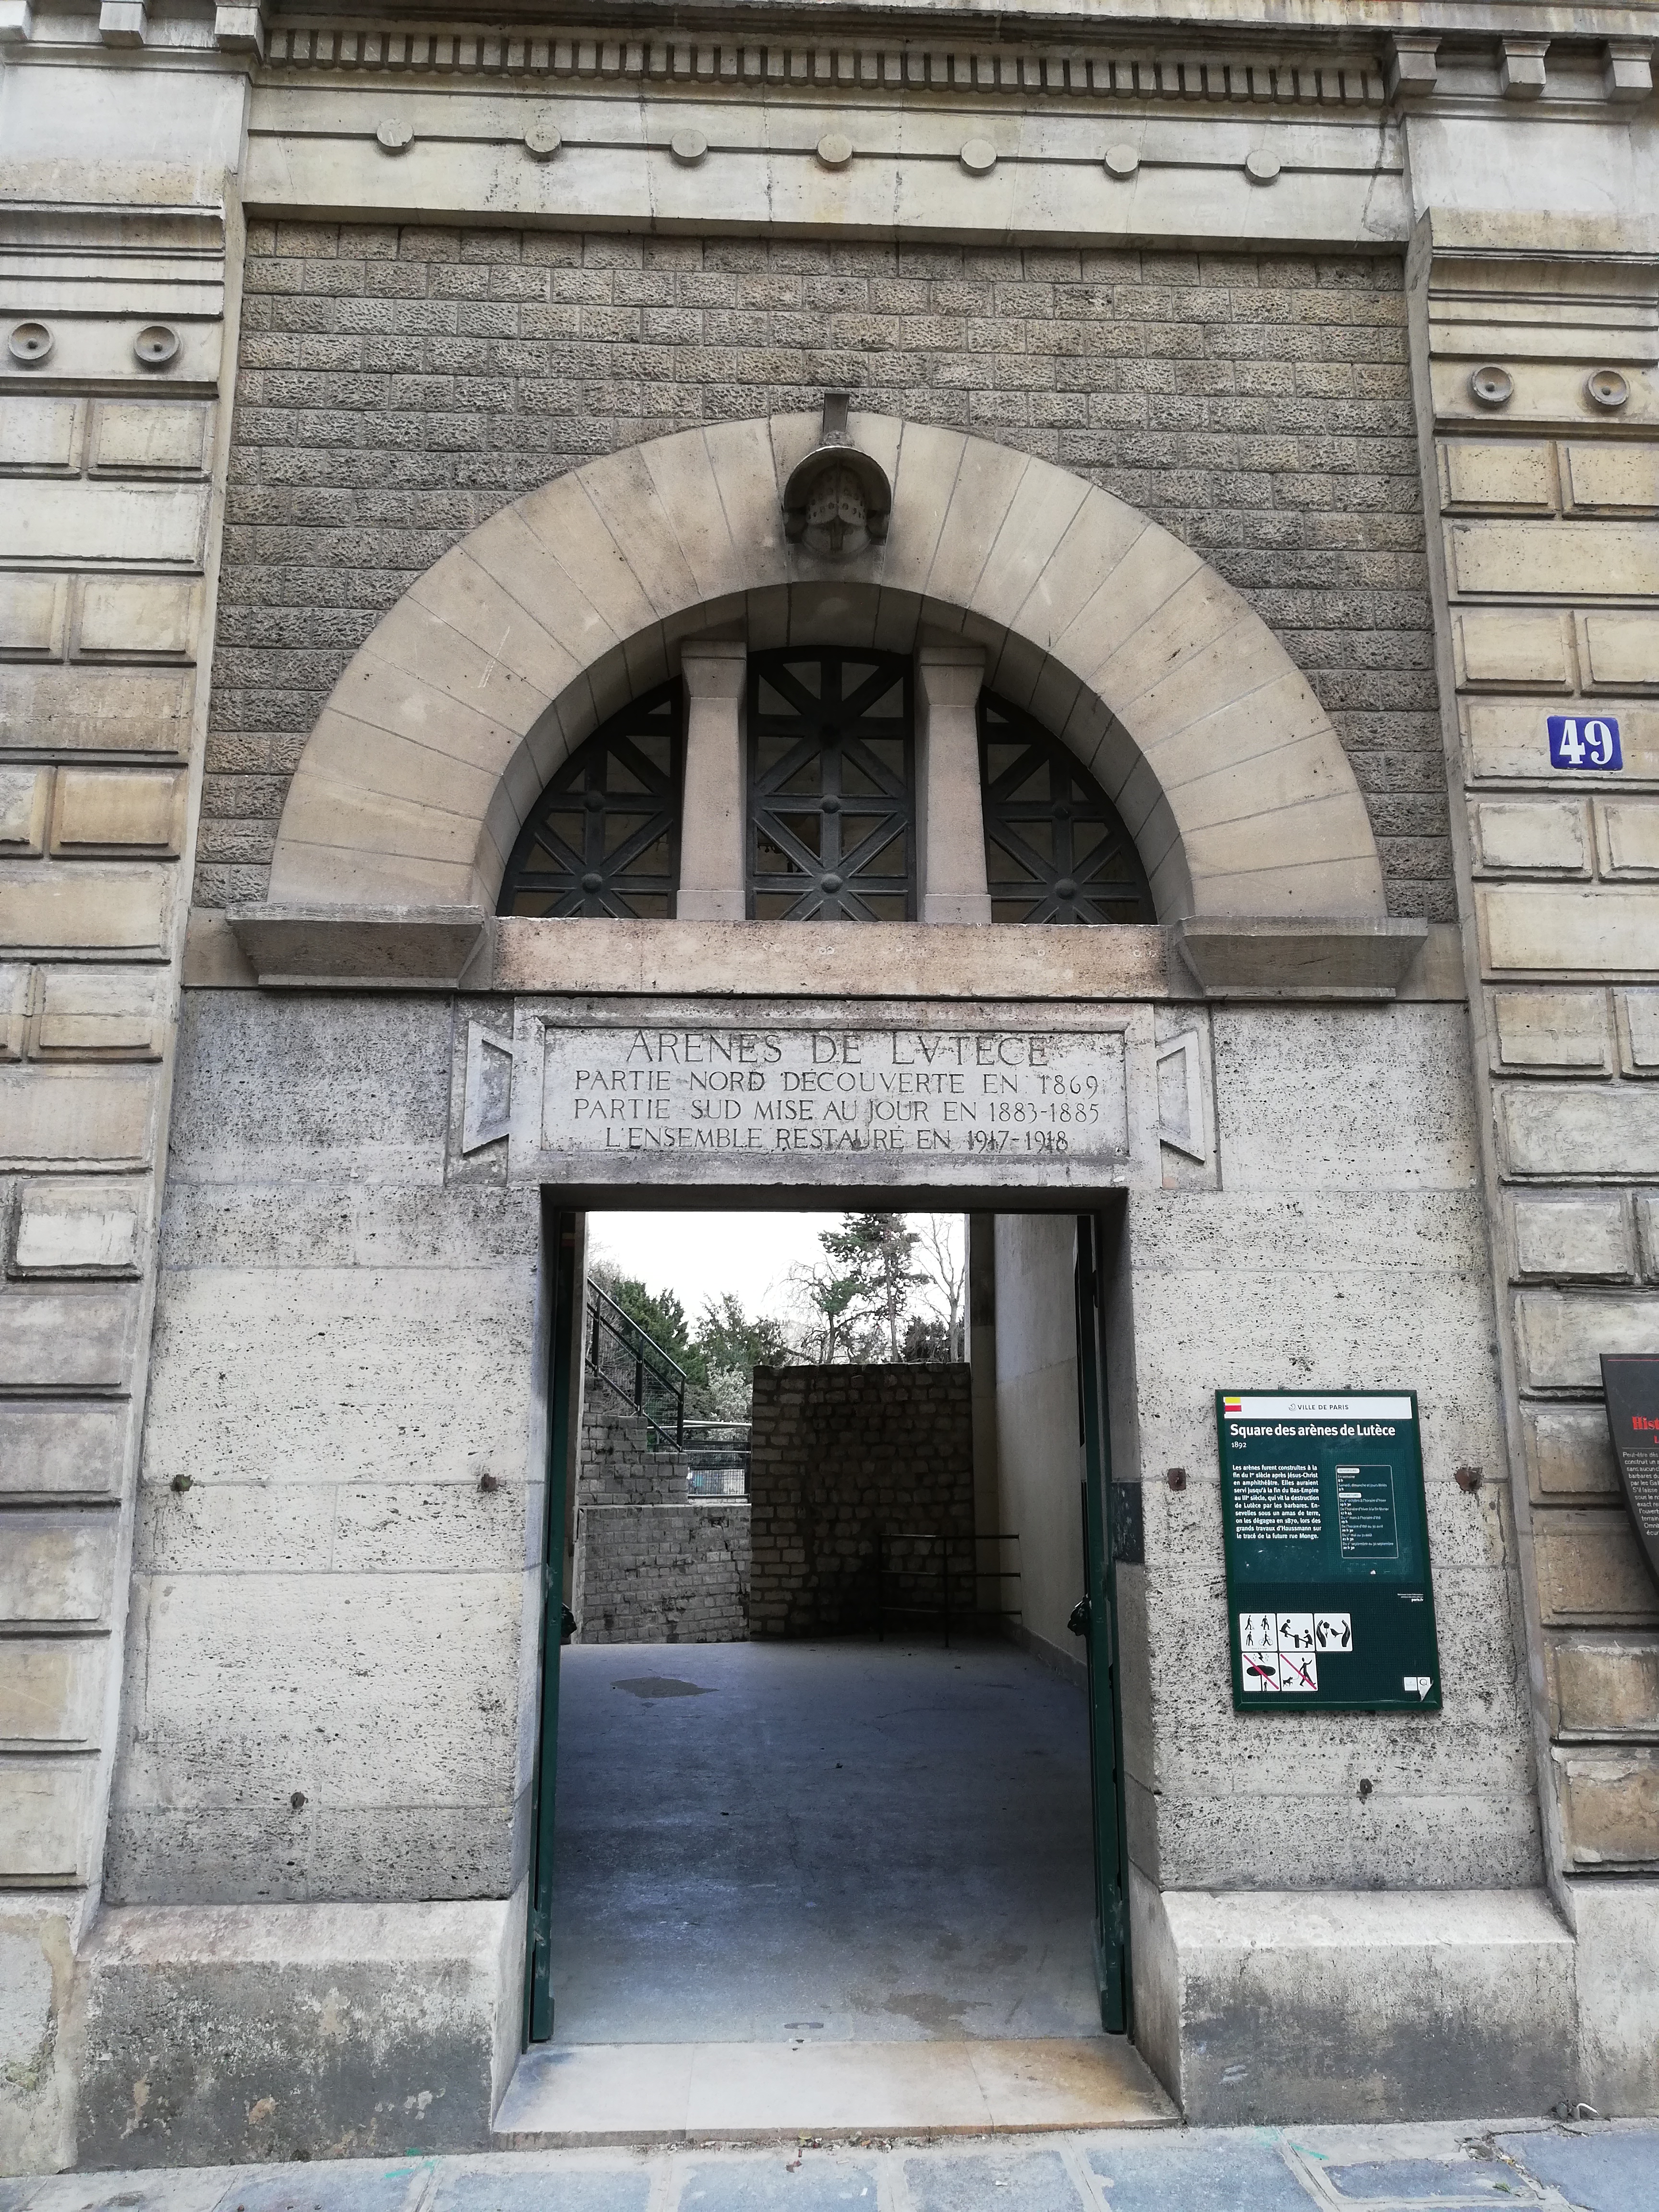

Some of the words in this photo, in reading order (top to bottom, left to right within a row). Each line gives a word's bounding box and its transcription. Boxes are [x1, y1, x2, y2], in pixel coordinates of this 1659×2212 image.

[1560, 720, 1613, 765] 49
[626, 1030, 781, 1064] ARENES
[812, 1035, 861, 1064] DE
[892, 1032, 1047, 1067] LVTECE
[576, 1070, 671, 1091] PARTIE
[690, 1071, 765, 1092] NORD
[984, 1074, 1017, 1094] EN
[1039, 1074, 1099, 1099] 1869
[575, 1099, 670, 1120] PARTIE
[691, 1099, 741, 1119] SUD
[754, 1100, 813, 1120] MISE
[822, 1100, 857, 1120] AU
[868, 1099, 929, 1123] JOUR
[944, 1102, 976, 1121] EN
[990, 1103, 1099, 1125] 1883-1885
[606, 1128, 762, 1148] L'ENSEMBLE
[776, 1125, 904, 1149] RESTAURÉ
[917, 1130, 950, 1149] EN
[968, 1130, 1068, 1153] 1917-1918
[1230, 1424, 1273, 1438] Square
[1275, 1424, 1296, 1436] des
[1298, 1424, 1337, 1436] arènes
[1342, 1424, 1355, 1436] de
[1357, 1424, 1395, 1436] Lutèce
